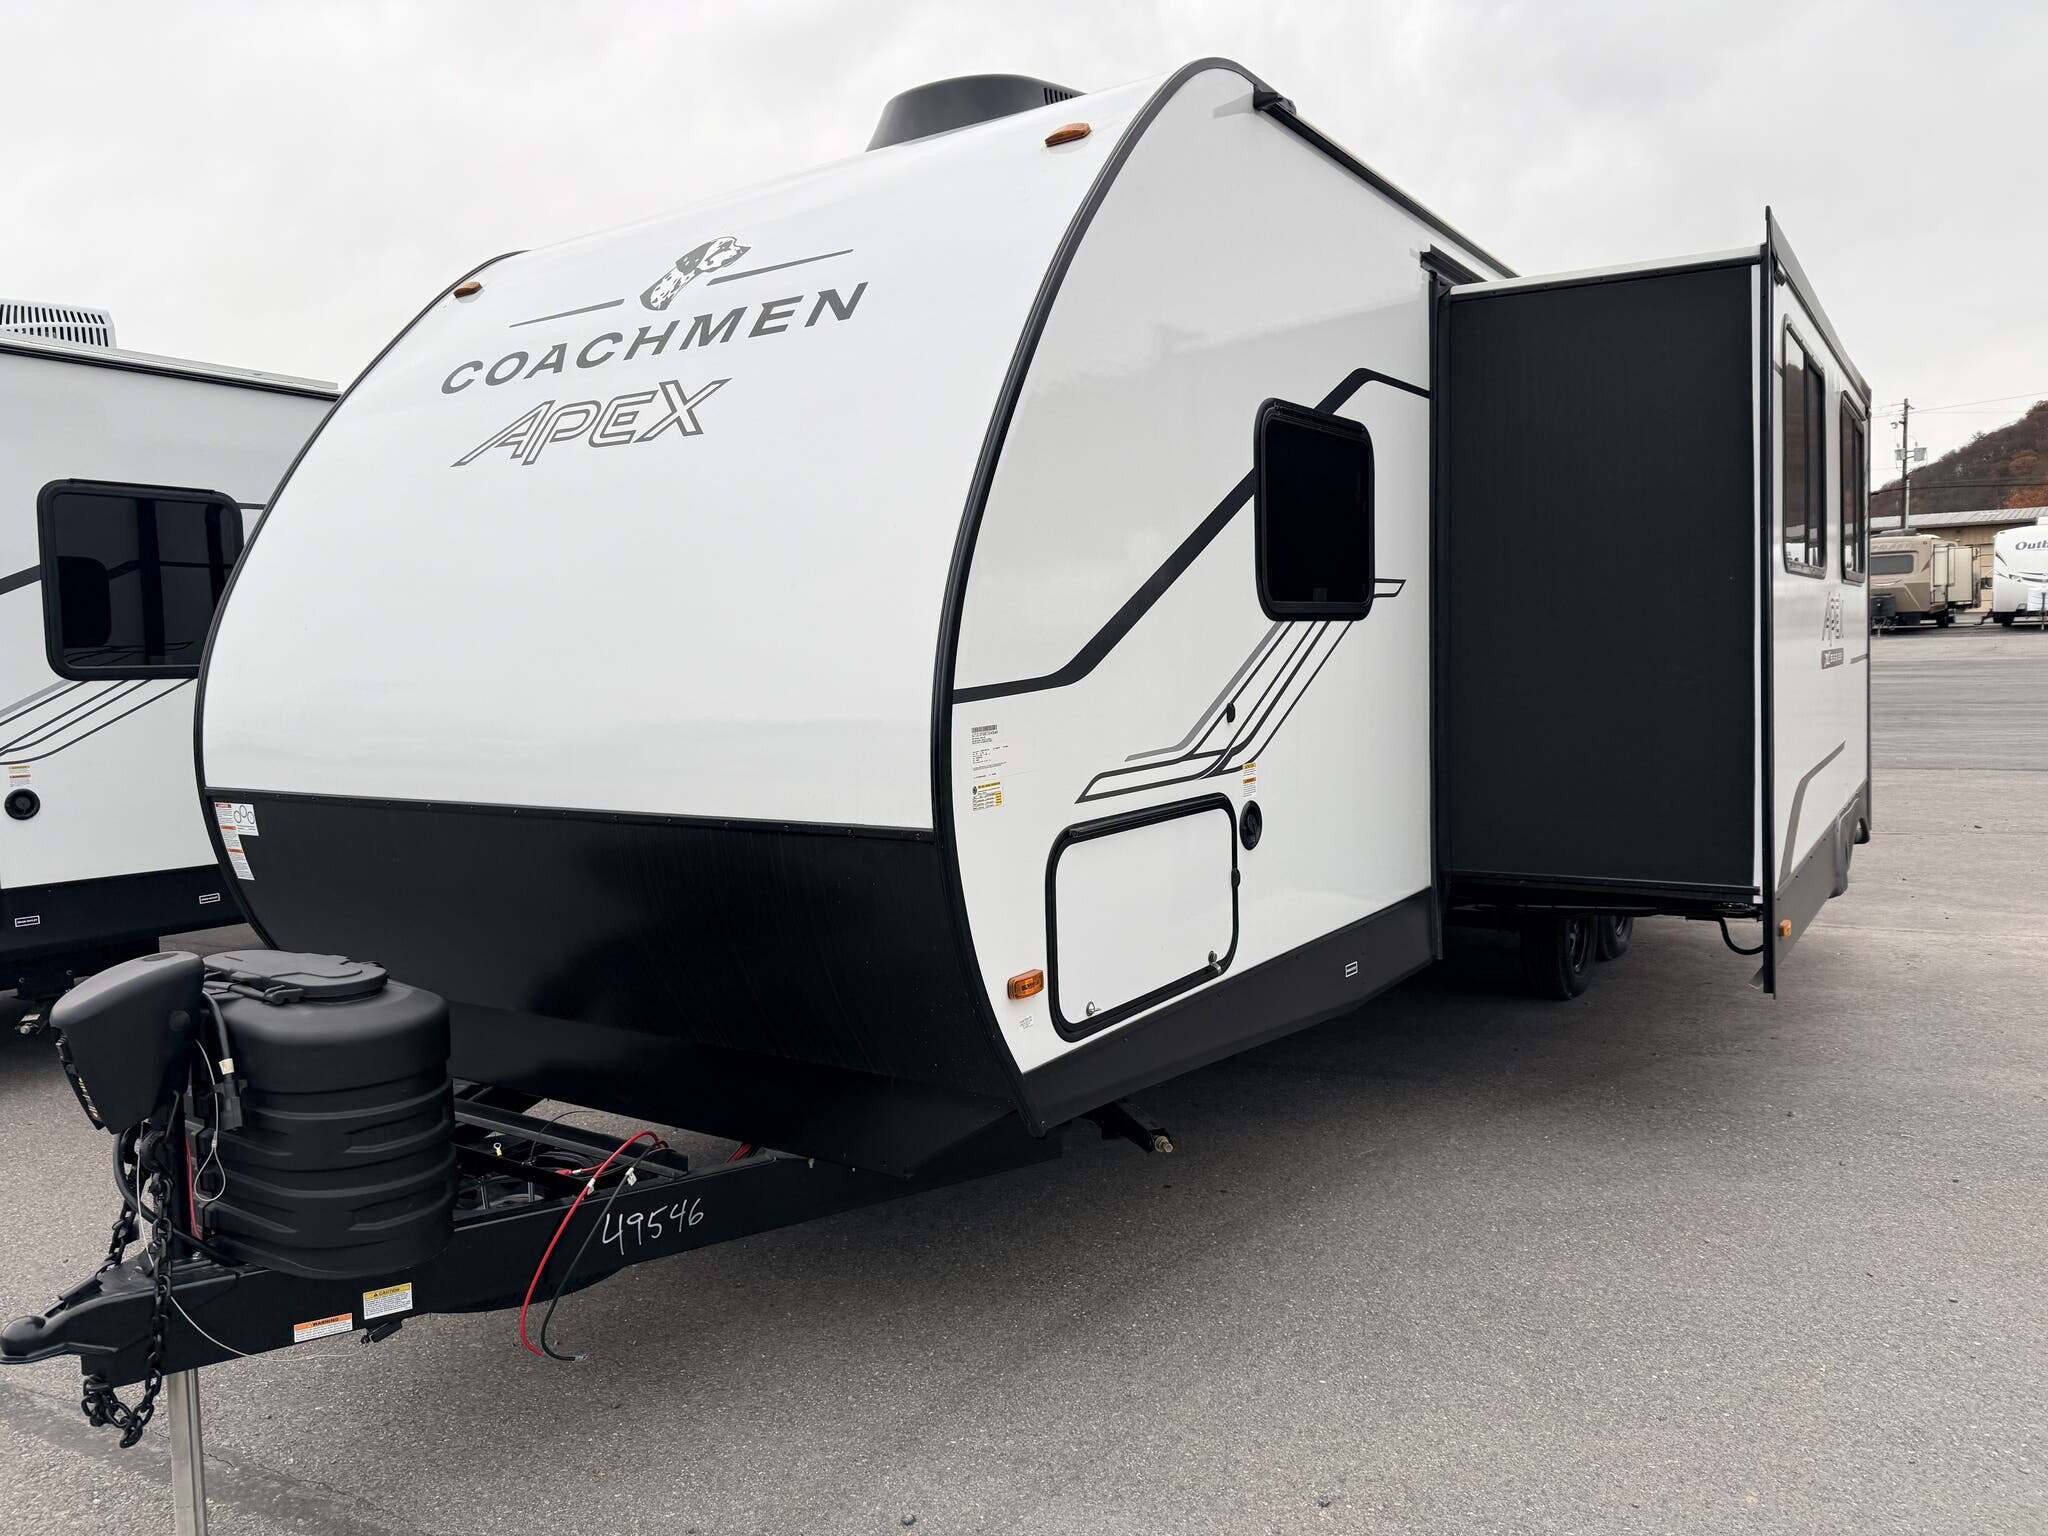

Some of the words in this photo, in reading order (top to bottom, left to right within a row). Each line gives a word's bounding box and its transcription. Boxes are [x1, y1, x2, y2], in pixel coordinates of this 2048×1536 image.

[441, 281, 869, 395] COACHMEN
[450, 377, 732, 468] APEX
[602, 1198, 704, 1256] 49546
